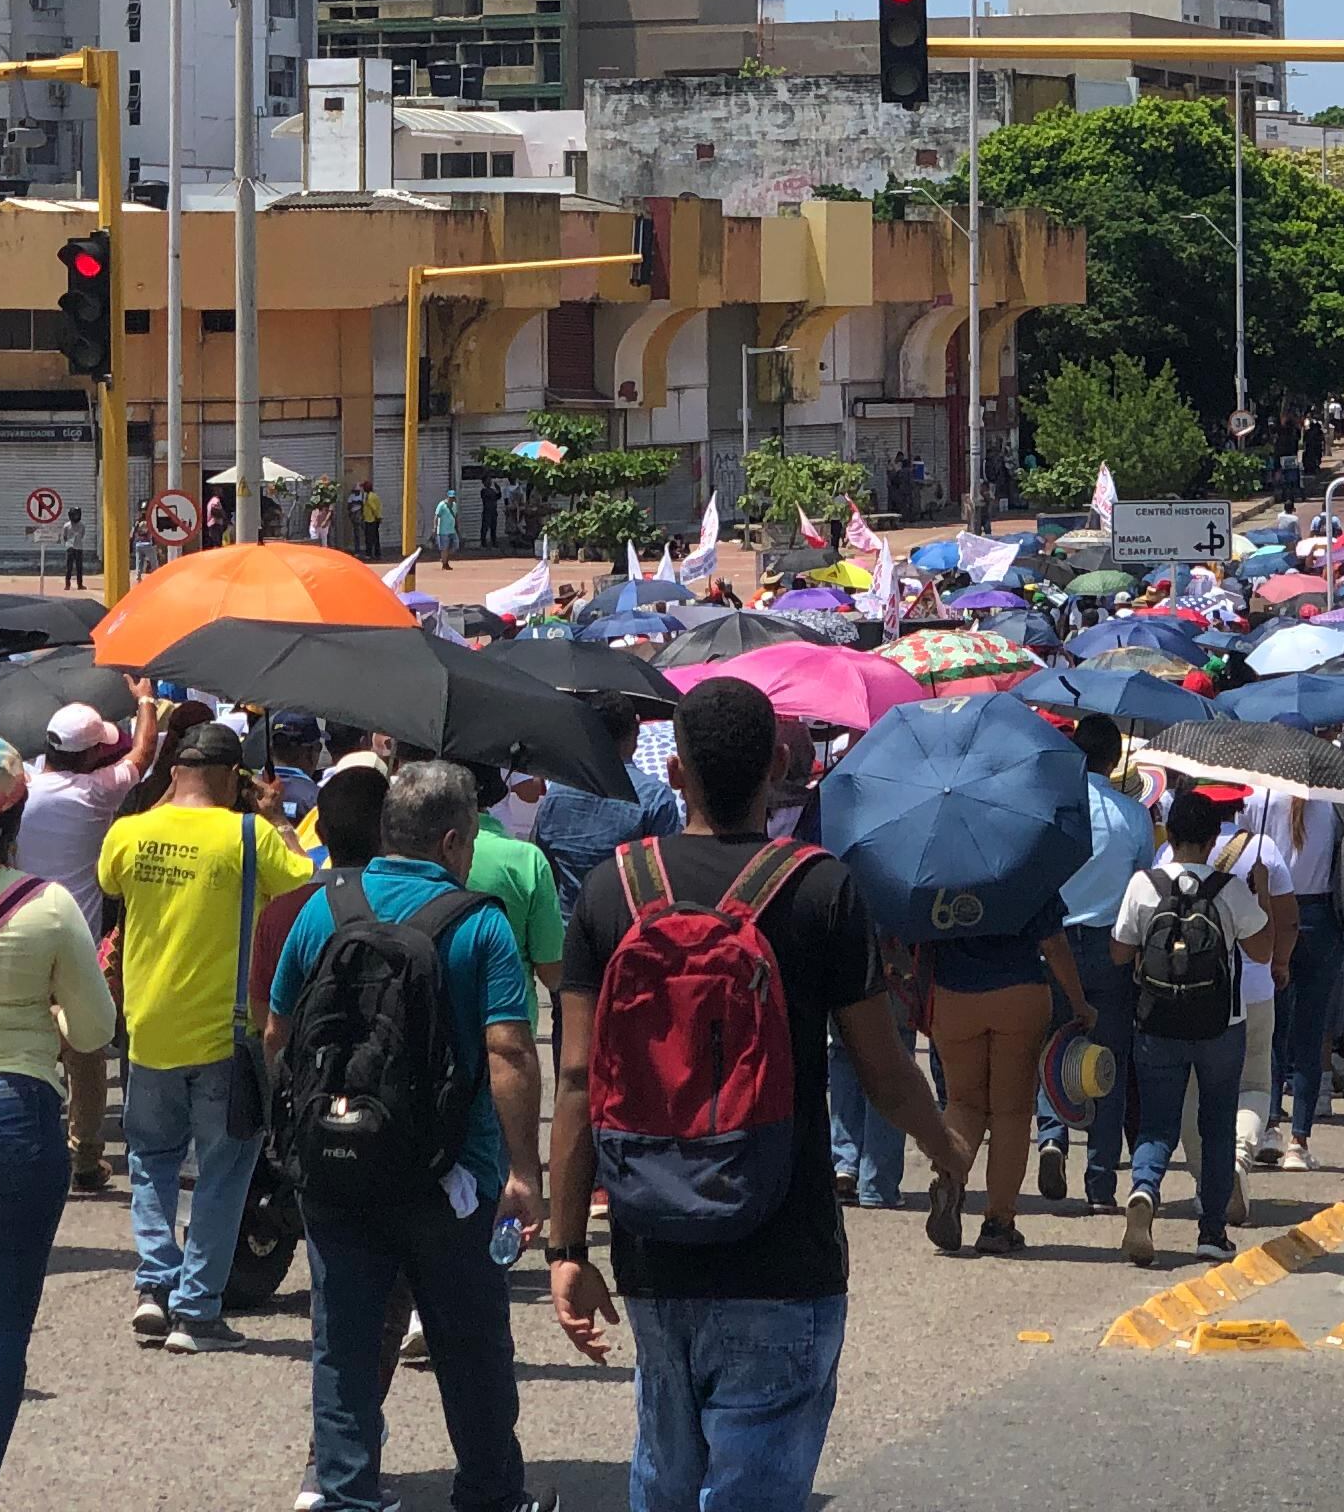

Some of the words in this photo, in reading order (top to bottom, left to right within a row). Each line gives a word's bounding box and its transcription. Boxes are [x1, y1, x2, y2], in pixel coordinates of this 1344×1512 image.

[62, 426, 83, 442] tigo
[1136, 508, 1173, 516] CENTRO
[1175, 508, 1225, 516] HISTORICO
[1119, 535, 1152, 543] MANGA
[1147, 548, 1179, 556] FELIPE
[137, 839, 200, 860] vamos
